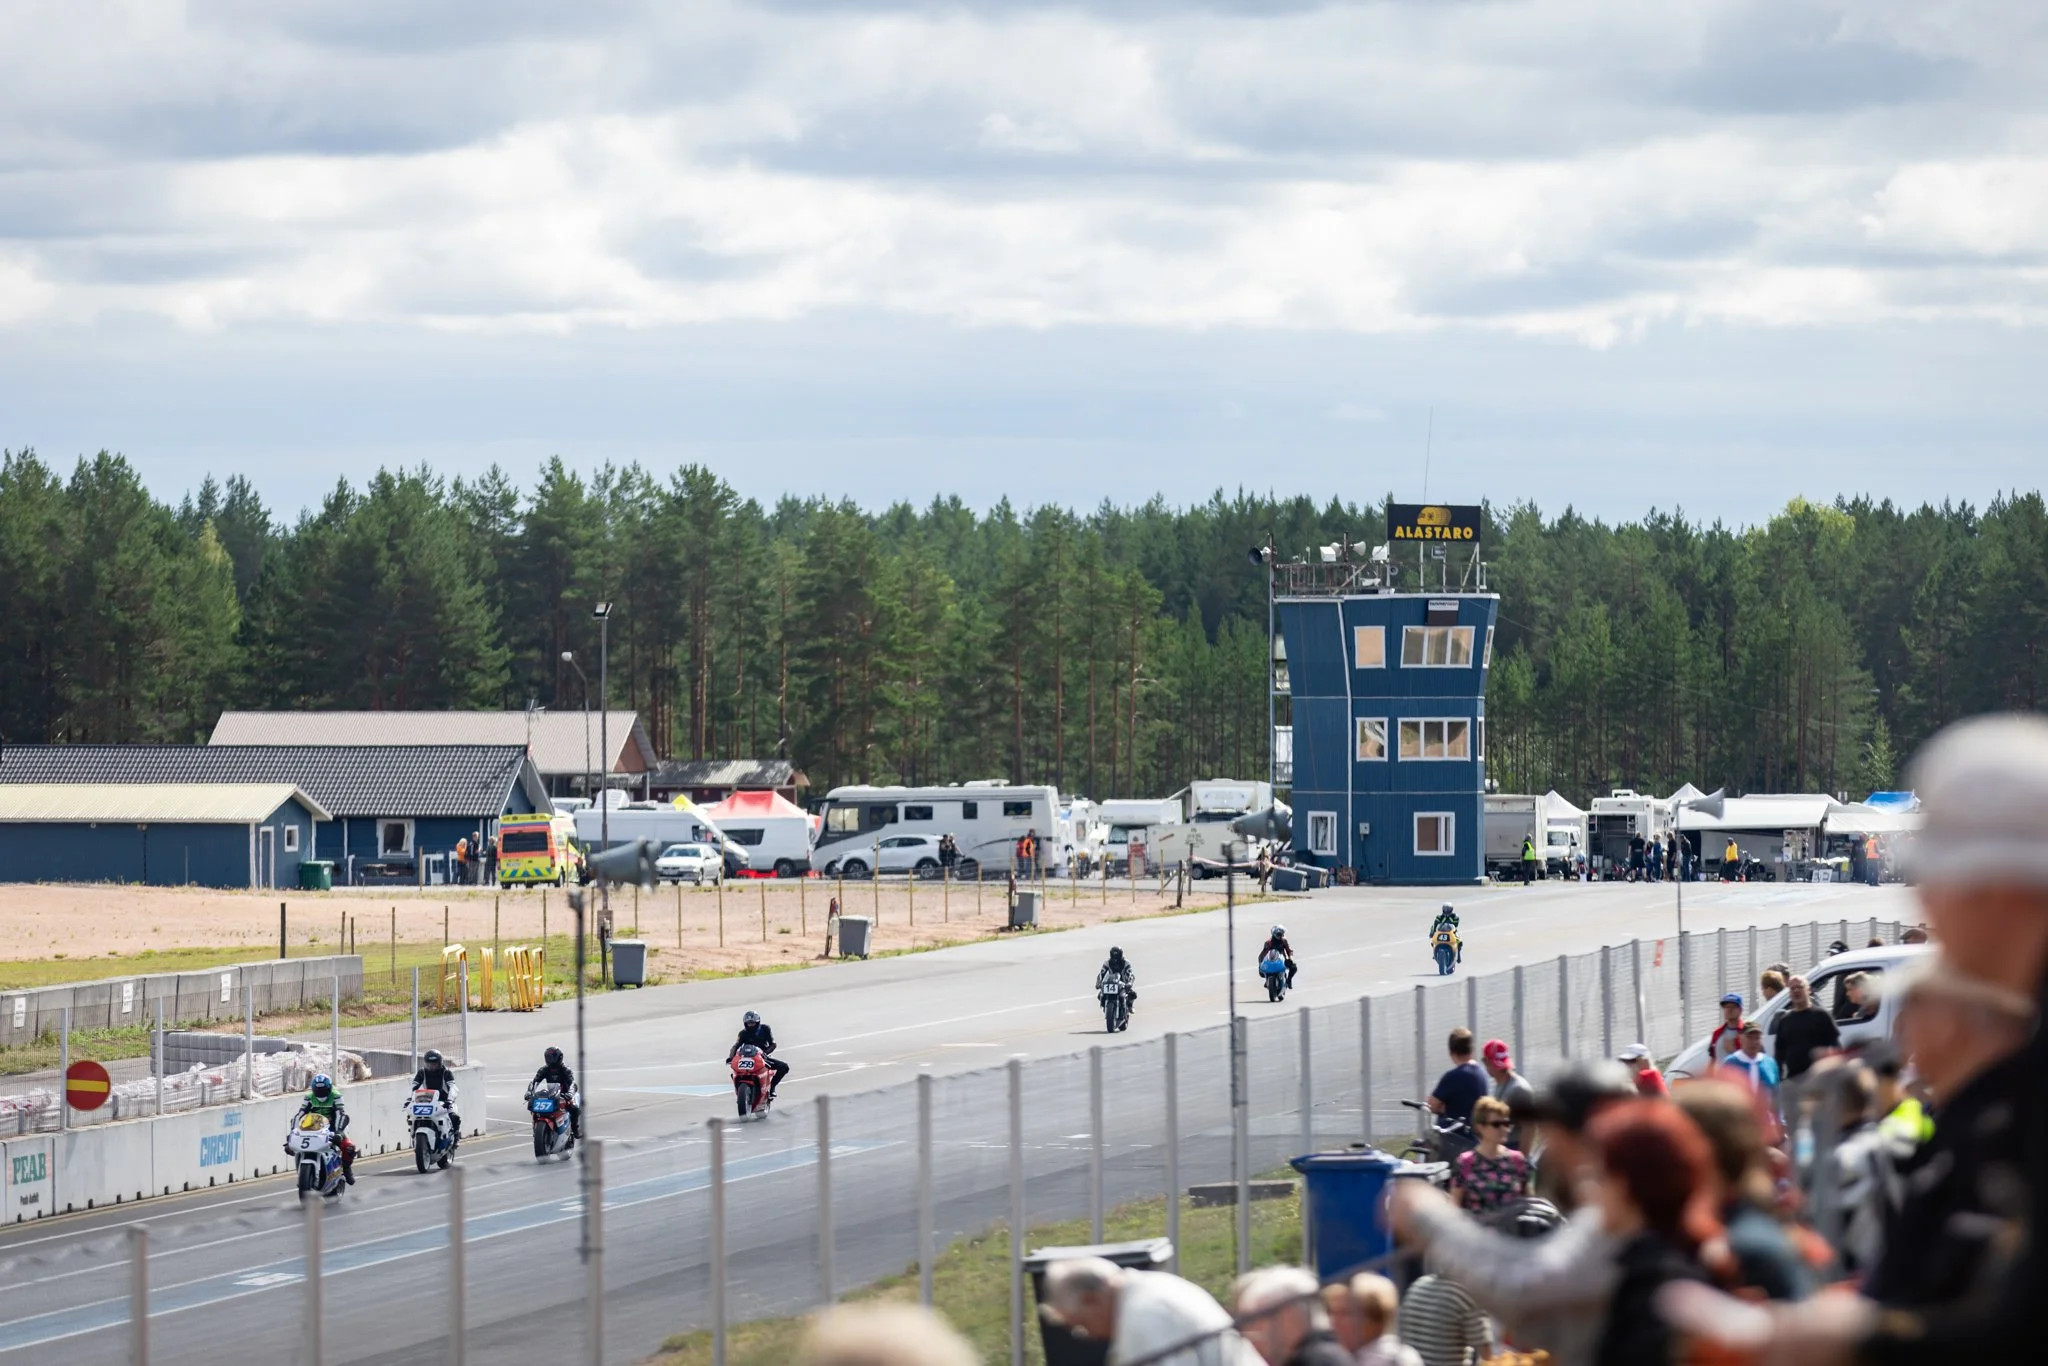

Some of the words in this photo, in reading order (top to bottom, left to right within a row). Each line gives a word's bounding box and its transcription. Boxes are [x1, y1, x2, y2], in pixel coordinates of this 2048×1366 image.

[1395, 525, 1473, 539] ALASTARO
[1106, 984, 1116, 993] 14
[738, 1060, 755, 1069] 259
[414, 1106, 432, 1114] 75
[533, 1101, 552, 1111] 257
[300, 1137, 310, 1149] 5
[200, 1131, 241, 1167] CIRCUIT
[12, 1152, 46, 1185] PEAB
